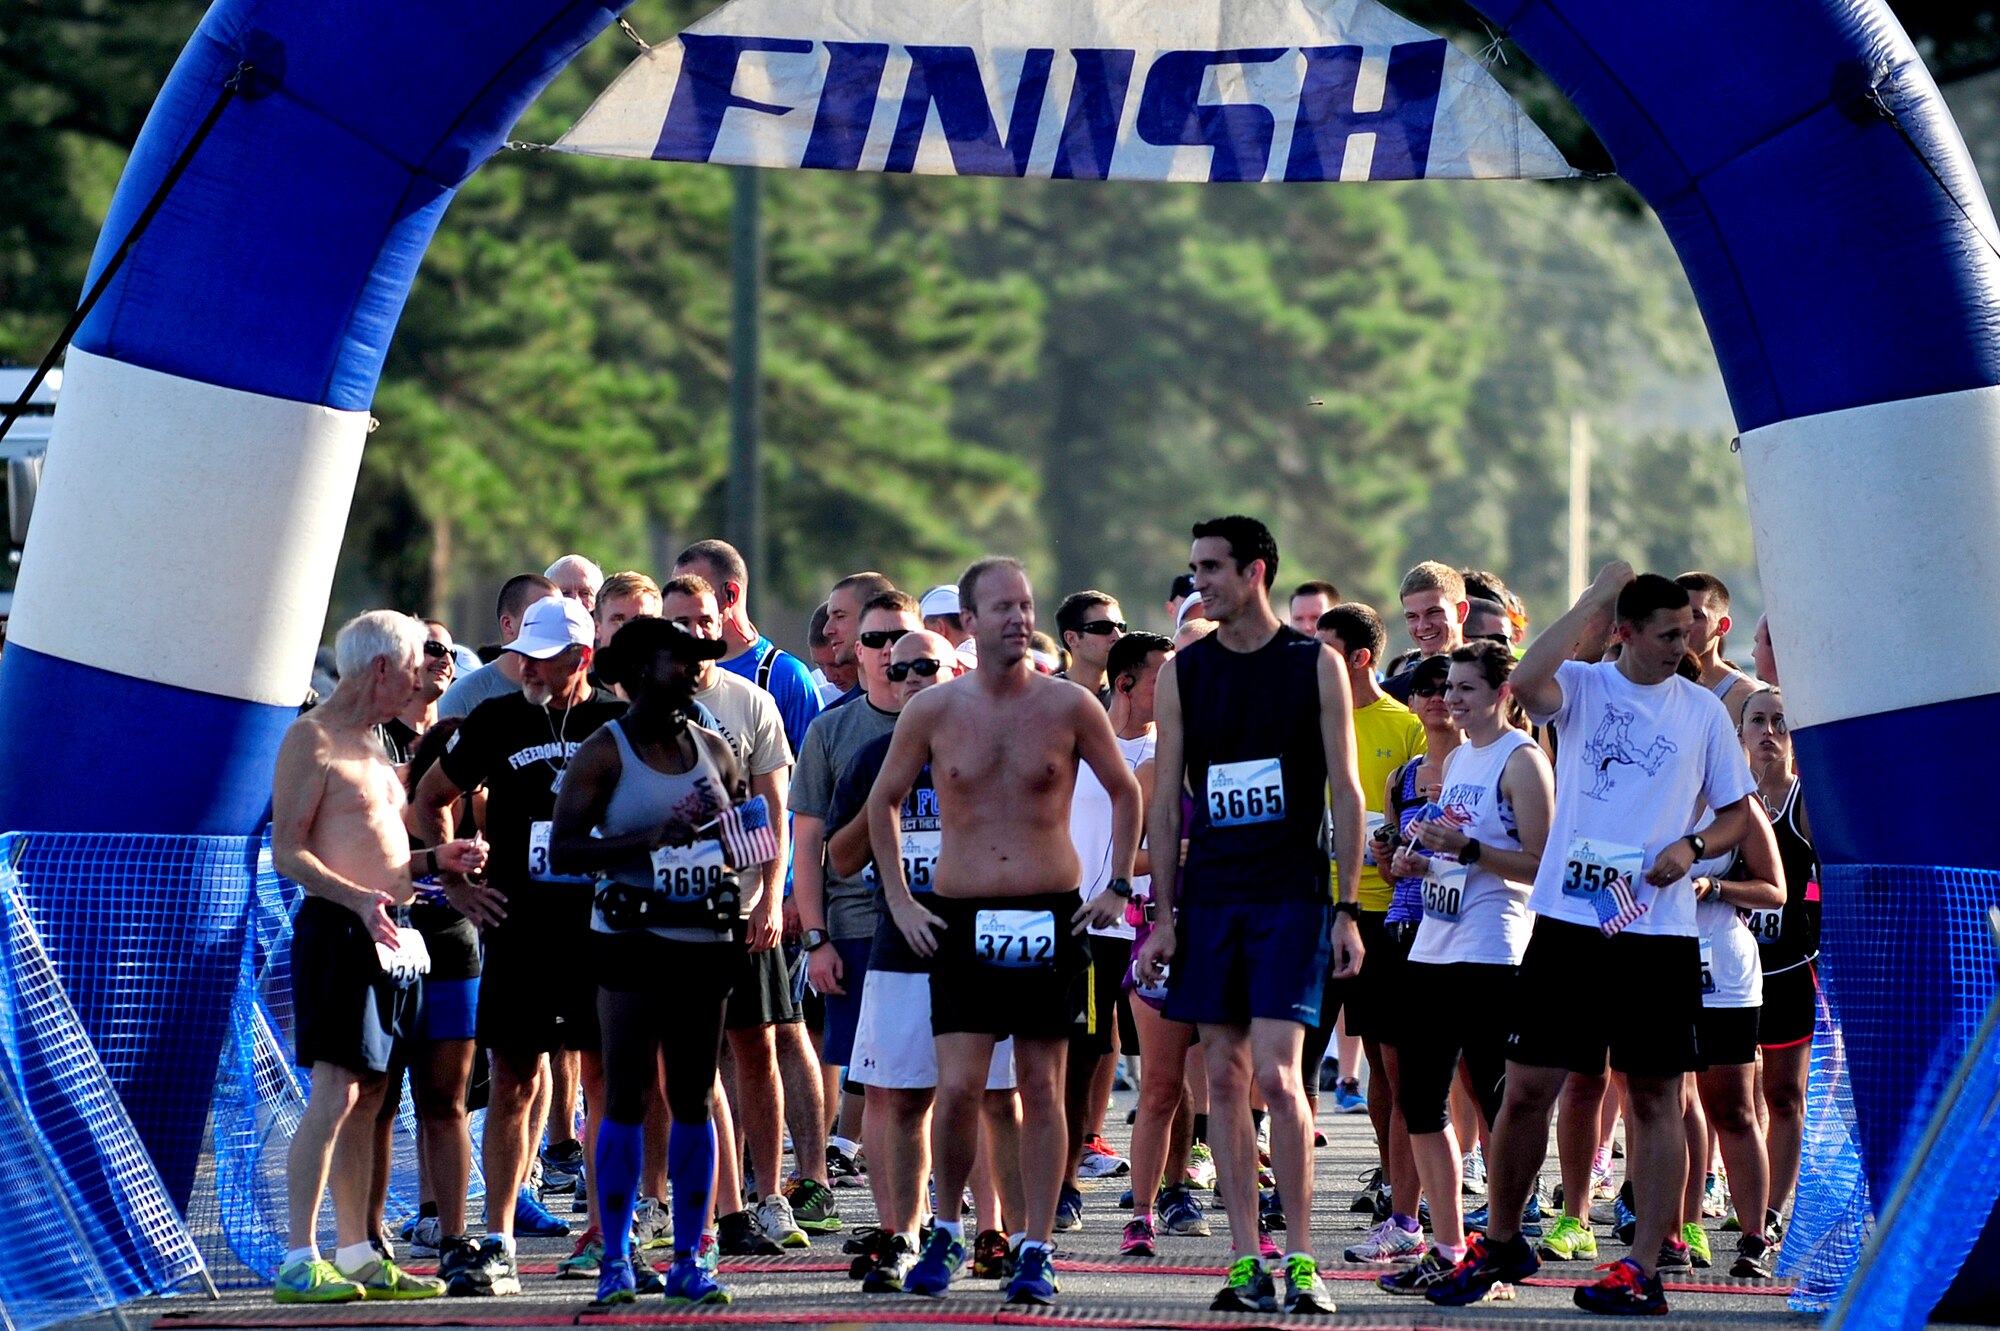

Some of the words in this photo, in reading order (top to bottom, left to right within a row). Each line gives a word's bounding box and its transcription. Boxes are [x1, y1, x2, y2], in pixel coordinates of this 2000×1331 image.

[651, 33, 1447, 182] FINISH
[508, 743, 563, 770] FREEDOM
[1211, 785, 1282, 820] 3665
[657, 865, 721, 897] 3699
[979, 934, 1053, 962] 3712
